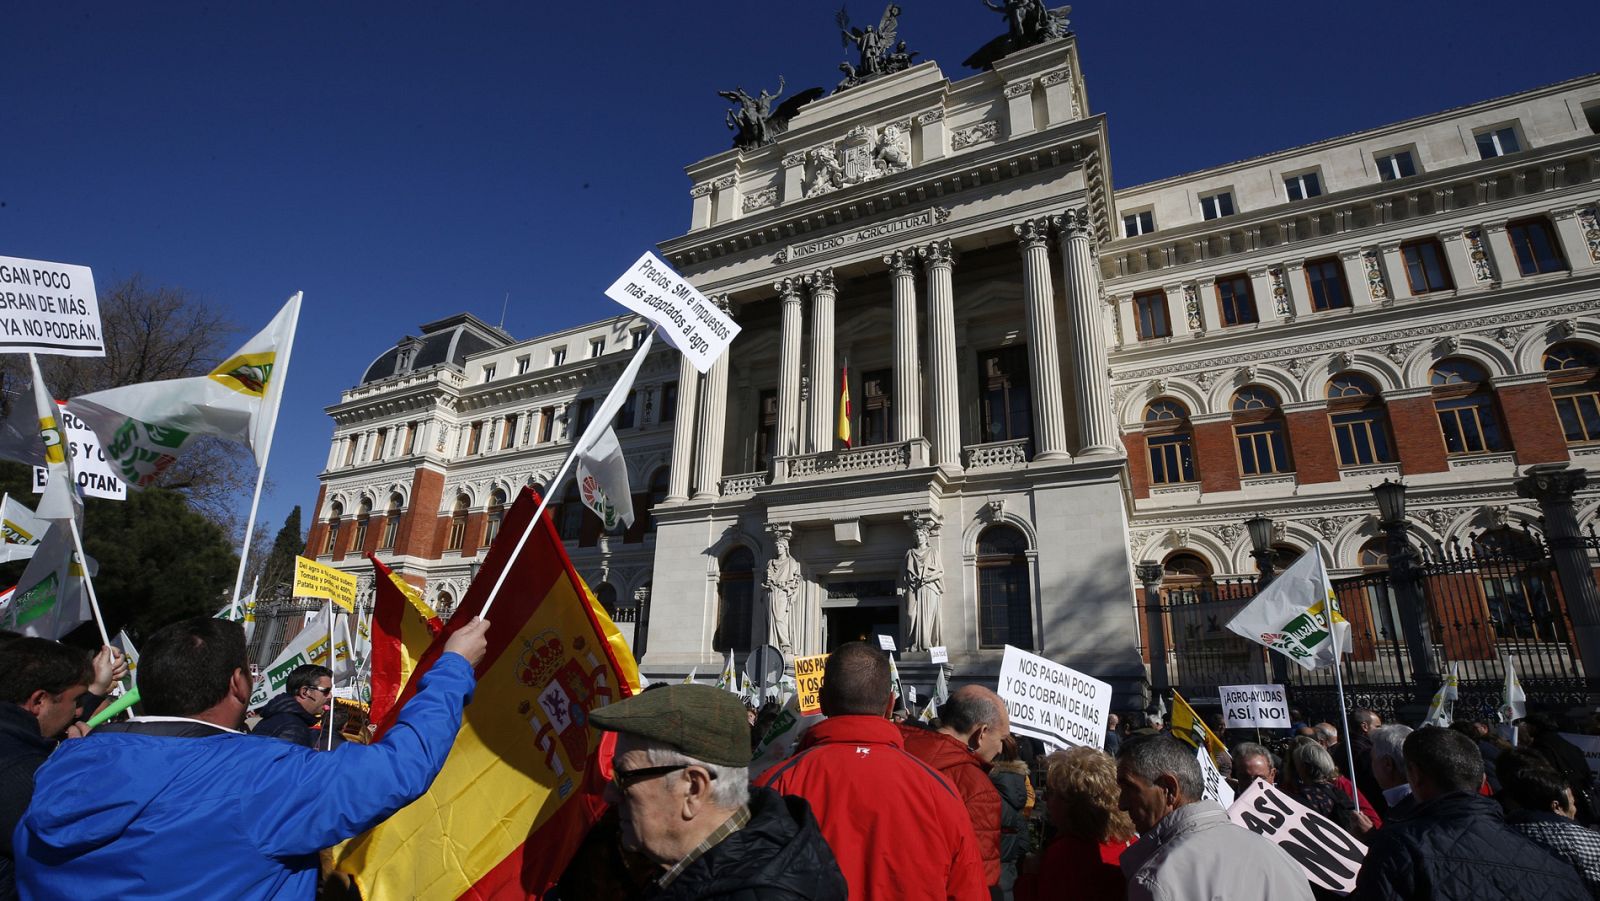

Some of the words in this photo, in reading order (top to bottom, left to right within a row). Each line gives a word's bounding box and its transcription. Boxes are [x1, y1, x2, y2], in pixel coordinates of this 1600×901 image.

[793, 236, 844, 258] MINISTERIO
[856, 214, 929, 243] AGRICULTURA
[33, 269, 71, 290] POCO
[38, 295, 56, 313] DE
[58, 294, 90, 316] MÁS.
[638, 258, 671, 292] Precios,
[671, 283, 691, 305] SMI
[687, 296, 695, 306] e
[692, 299, 731, 342] impuestos
[0, 318, 22, 336] YA
[23, 319, 43, 337] NO
[44, 320, 100, 341] PODRÁN.
[624, 280, 647, 303] más
[643, 290, 685, 330] adaptados
[683, 322, 692, 337] al
[689, 335, 709, 357] agro.
[83, 443, 93, 459] Y
[797, 659, 814, 674] NOS
[1019, 658, 1038, 677] NOS
[1039, 665, 1071, 689] PAGAN
[1072, 677, 1096, 700] POCO
[799, 678, 805, 692] Y
[807, 677, 819, 692] OS
[1006, 676, 1013, 691] Y
[1014, 679, 1027, 697] OS
[1029, 684, 1068, 710] COBRAN
[1068, 698, 1081, 716] DE
[1082, 704, 1100, 726] MÁS.
[1004, 699, 1037, 725] NIDOS,
[1040, 708, 1051, 727] YA
[1053, 713, 1065, 732] NO
[1227, 704, 1256, 722] ASÍ,
[1259, 706, 1286, 721] NO!
[1240, 781, 1295, 836] ASÍ
[1278, 812, 1366, 890] NO
